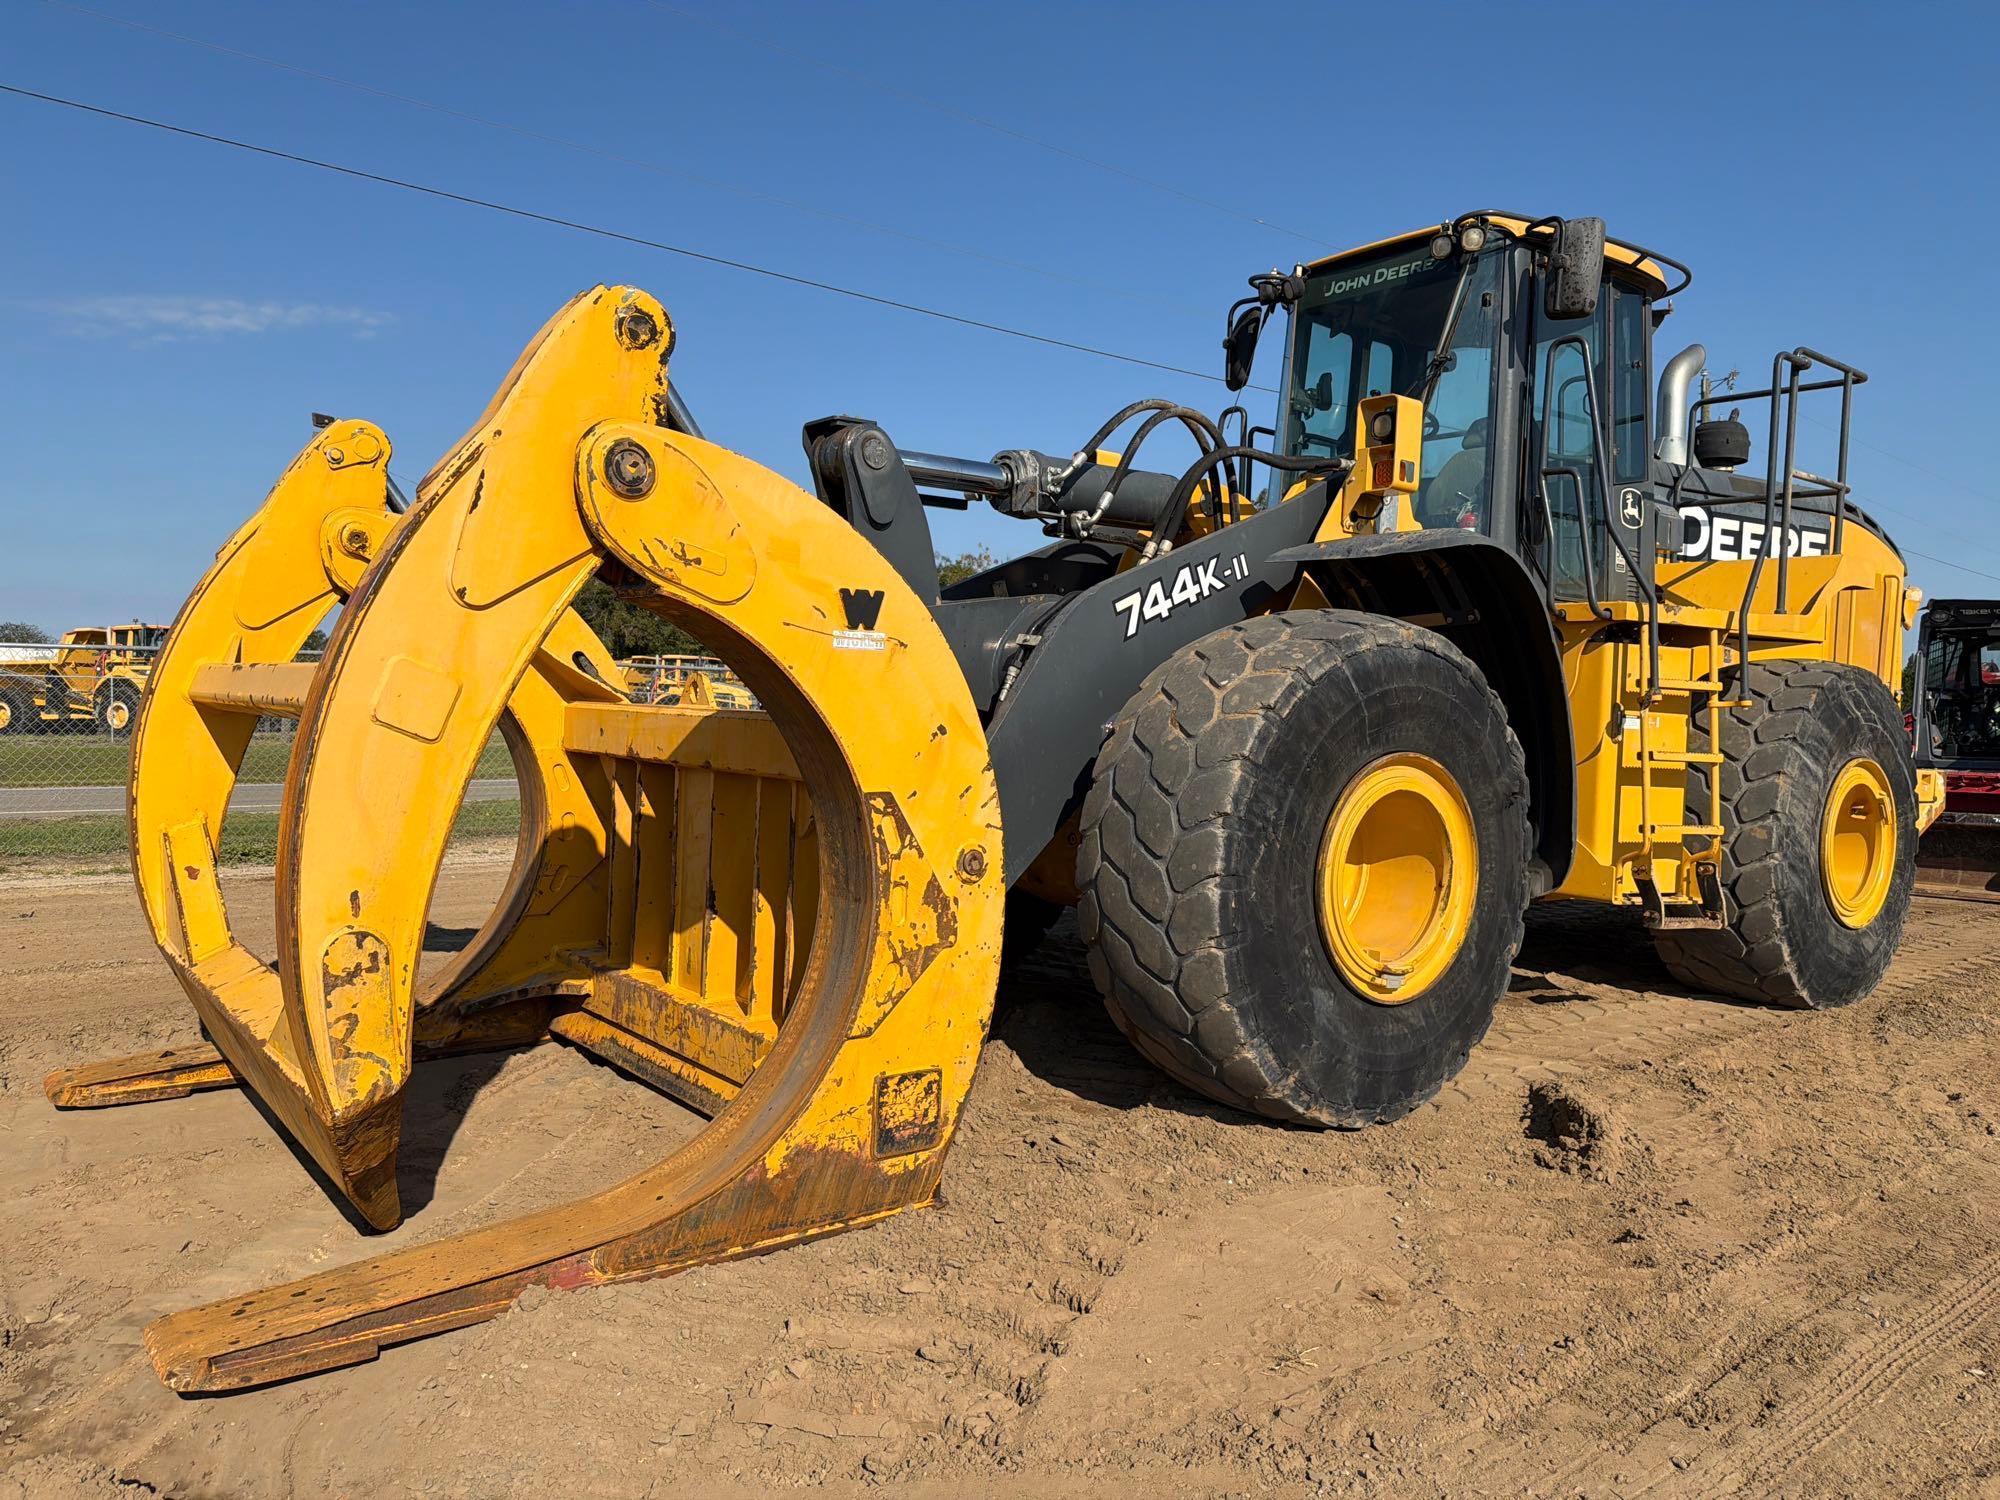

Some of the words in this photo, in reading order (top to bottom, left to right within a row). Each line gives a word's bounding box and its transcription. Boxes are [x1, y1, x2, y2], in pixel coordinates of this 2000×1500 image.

[1324, 274, 1371, 297] JOHN
[1373, 258, 1436, 284] DEERE
[1676, 505, 1828, 562] DEERE
[839, 588, 885, 630] W
[1113, 553, 1250, 641] 744K-II
